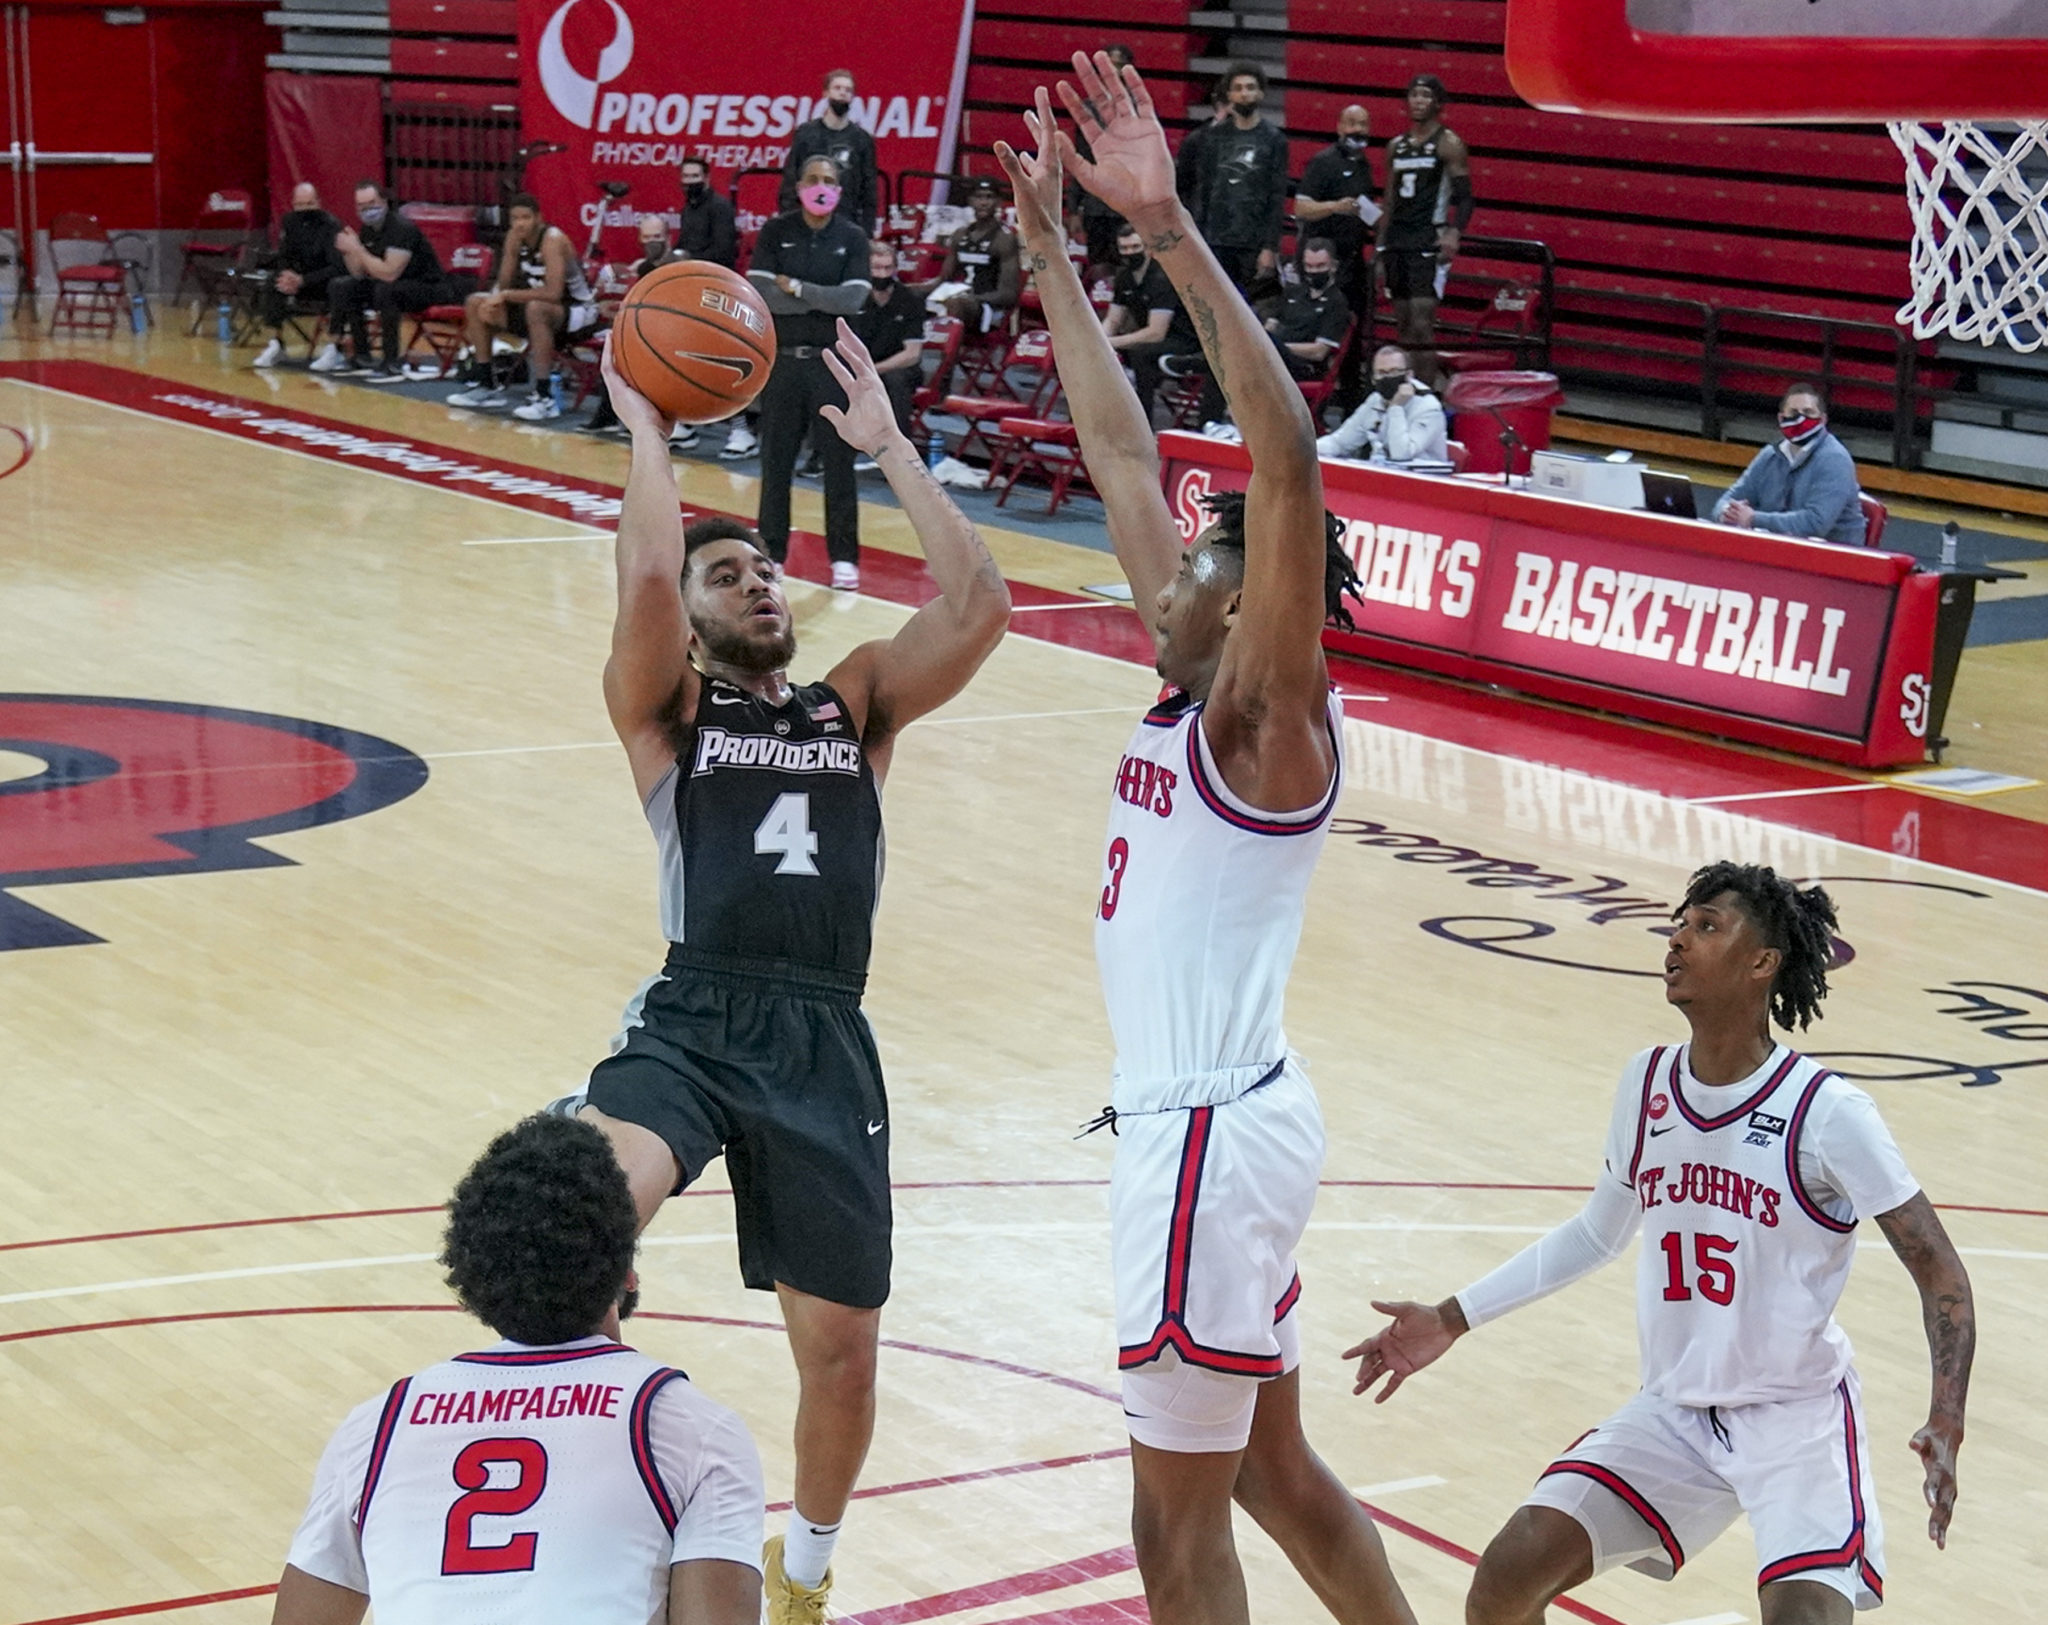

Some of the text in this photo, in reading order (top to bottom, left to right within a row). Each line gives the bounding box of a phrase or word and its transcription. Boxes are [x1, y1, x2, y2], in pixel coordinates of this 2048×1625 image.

[597, 92, 939, 138] PROFESSINAL
[591, 141, 791, 169] PHYSICAL THERAPY
[700, 288, 765, 338] ELITE
[1334, 515, 1851, 696] OHN'S BASKETBALL
[693, 728, 861, 776] PROVIDENCE
[1113, 753, 1178, 819] HN'S
[754, 792, 821, 877] 4
[1098, 836, 1130, 922] 3
[1667, 1162, 1782, 1228] JOHN'S
[1661, 1230, 1740, 1307] 15
[409, 1383, 624, 1425] CHAMPAGNIE
[440, 1437, 549, 1577] 2
